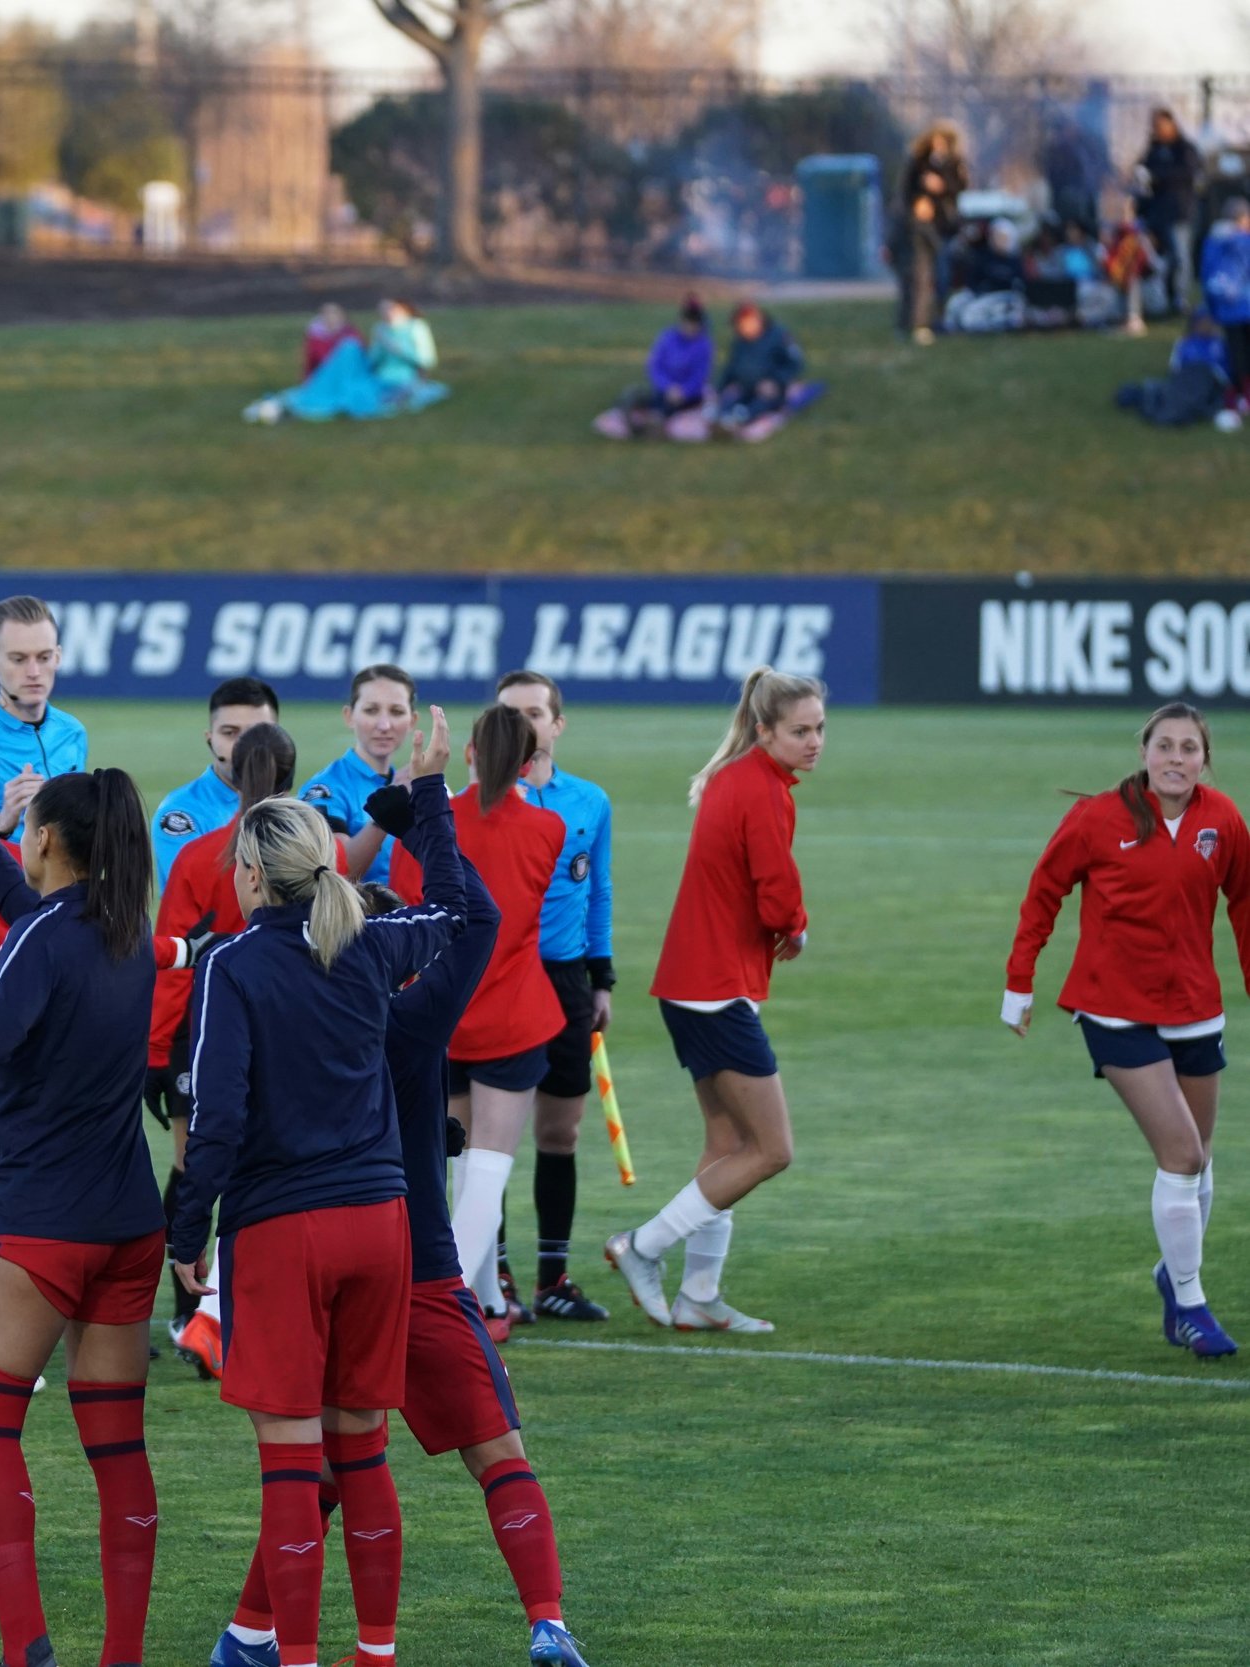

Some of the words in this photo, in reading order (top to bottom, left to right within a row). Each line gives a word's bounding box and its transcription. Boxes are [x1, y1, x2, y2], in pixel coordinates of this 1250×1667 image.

[208, 603, 501, 677] SOCCER
[525, 605, 831, 677] LEAGUE
[980, 600, 1132, 692] NIKE
